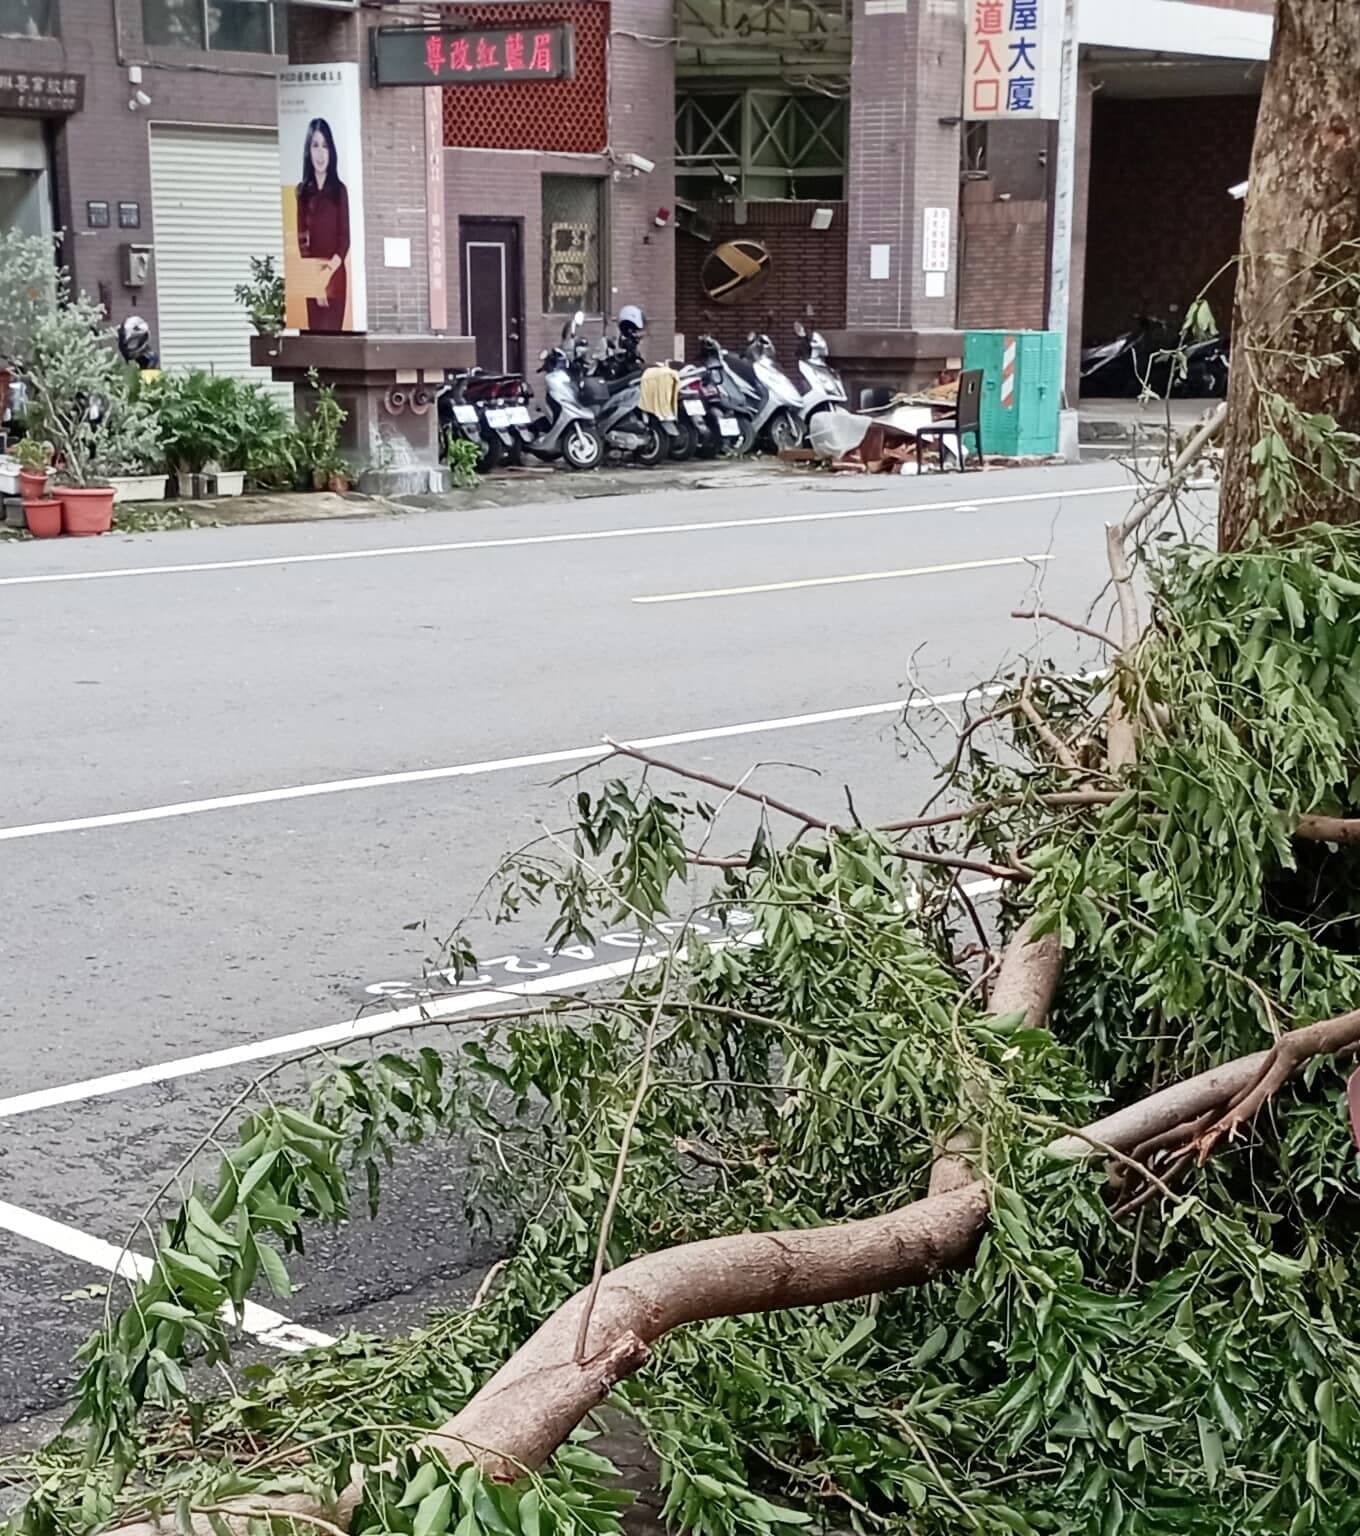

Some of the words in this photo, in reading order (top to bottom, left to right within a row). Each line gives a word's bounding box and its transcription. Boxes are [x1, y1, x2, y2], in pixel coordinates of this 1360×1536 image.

[424, 32, 552, 76] 專改紅藍眉
